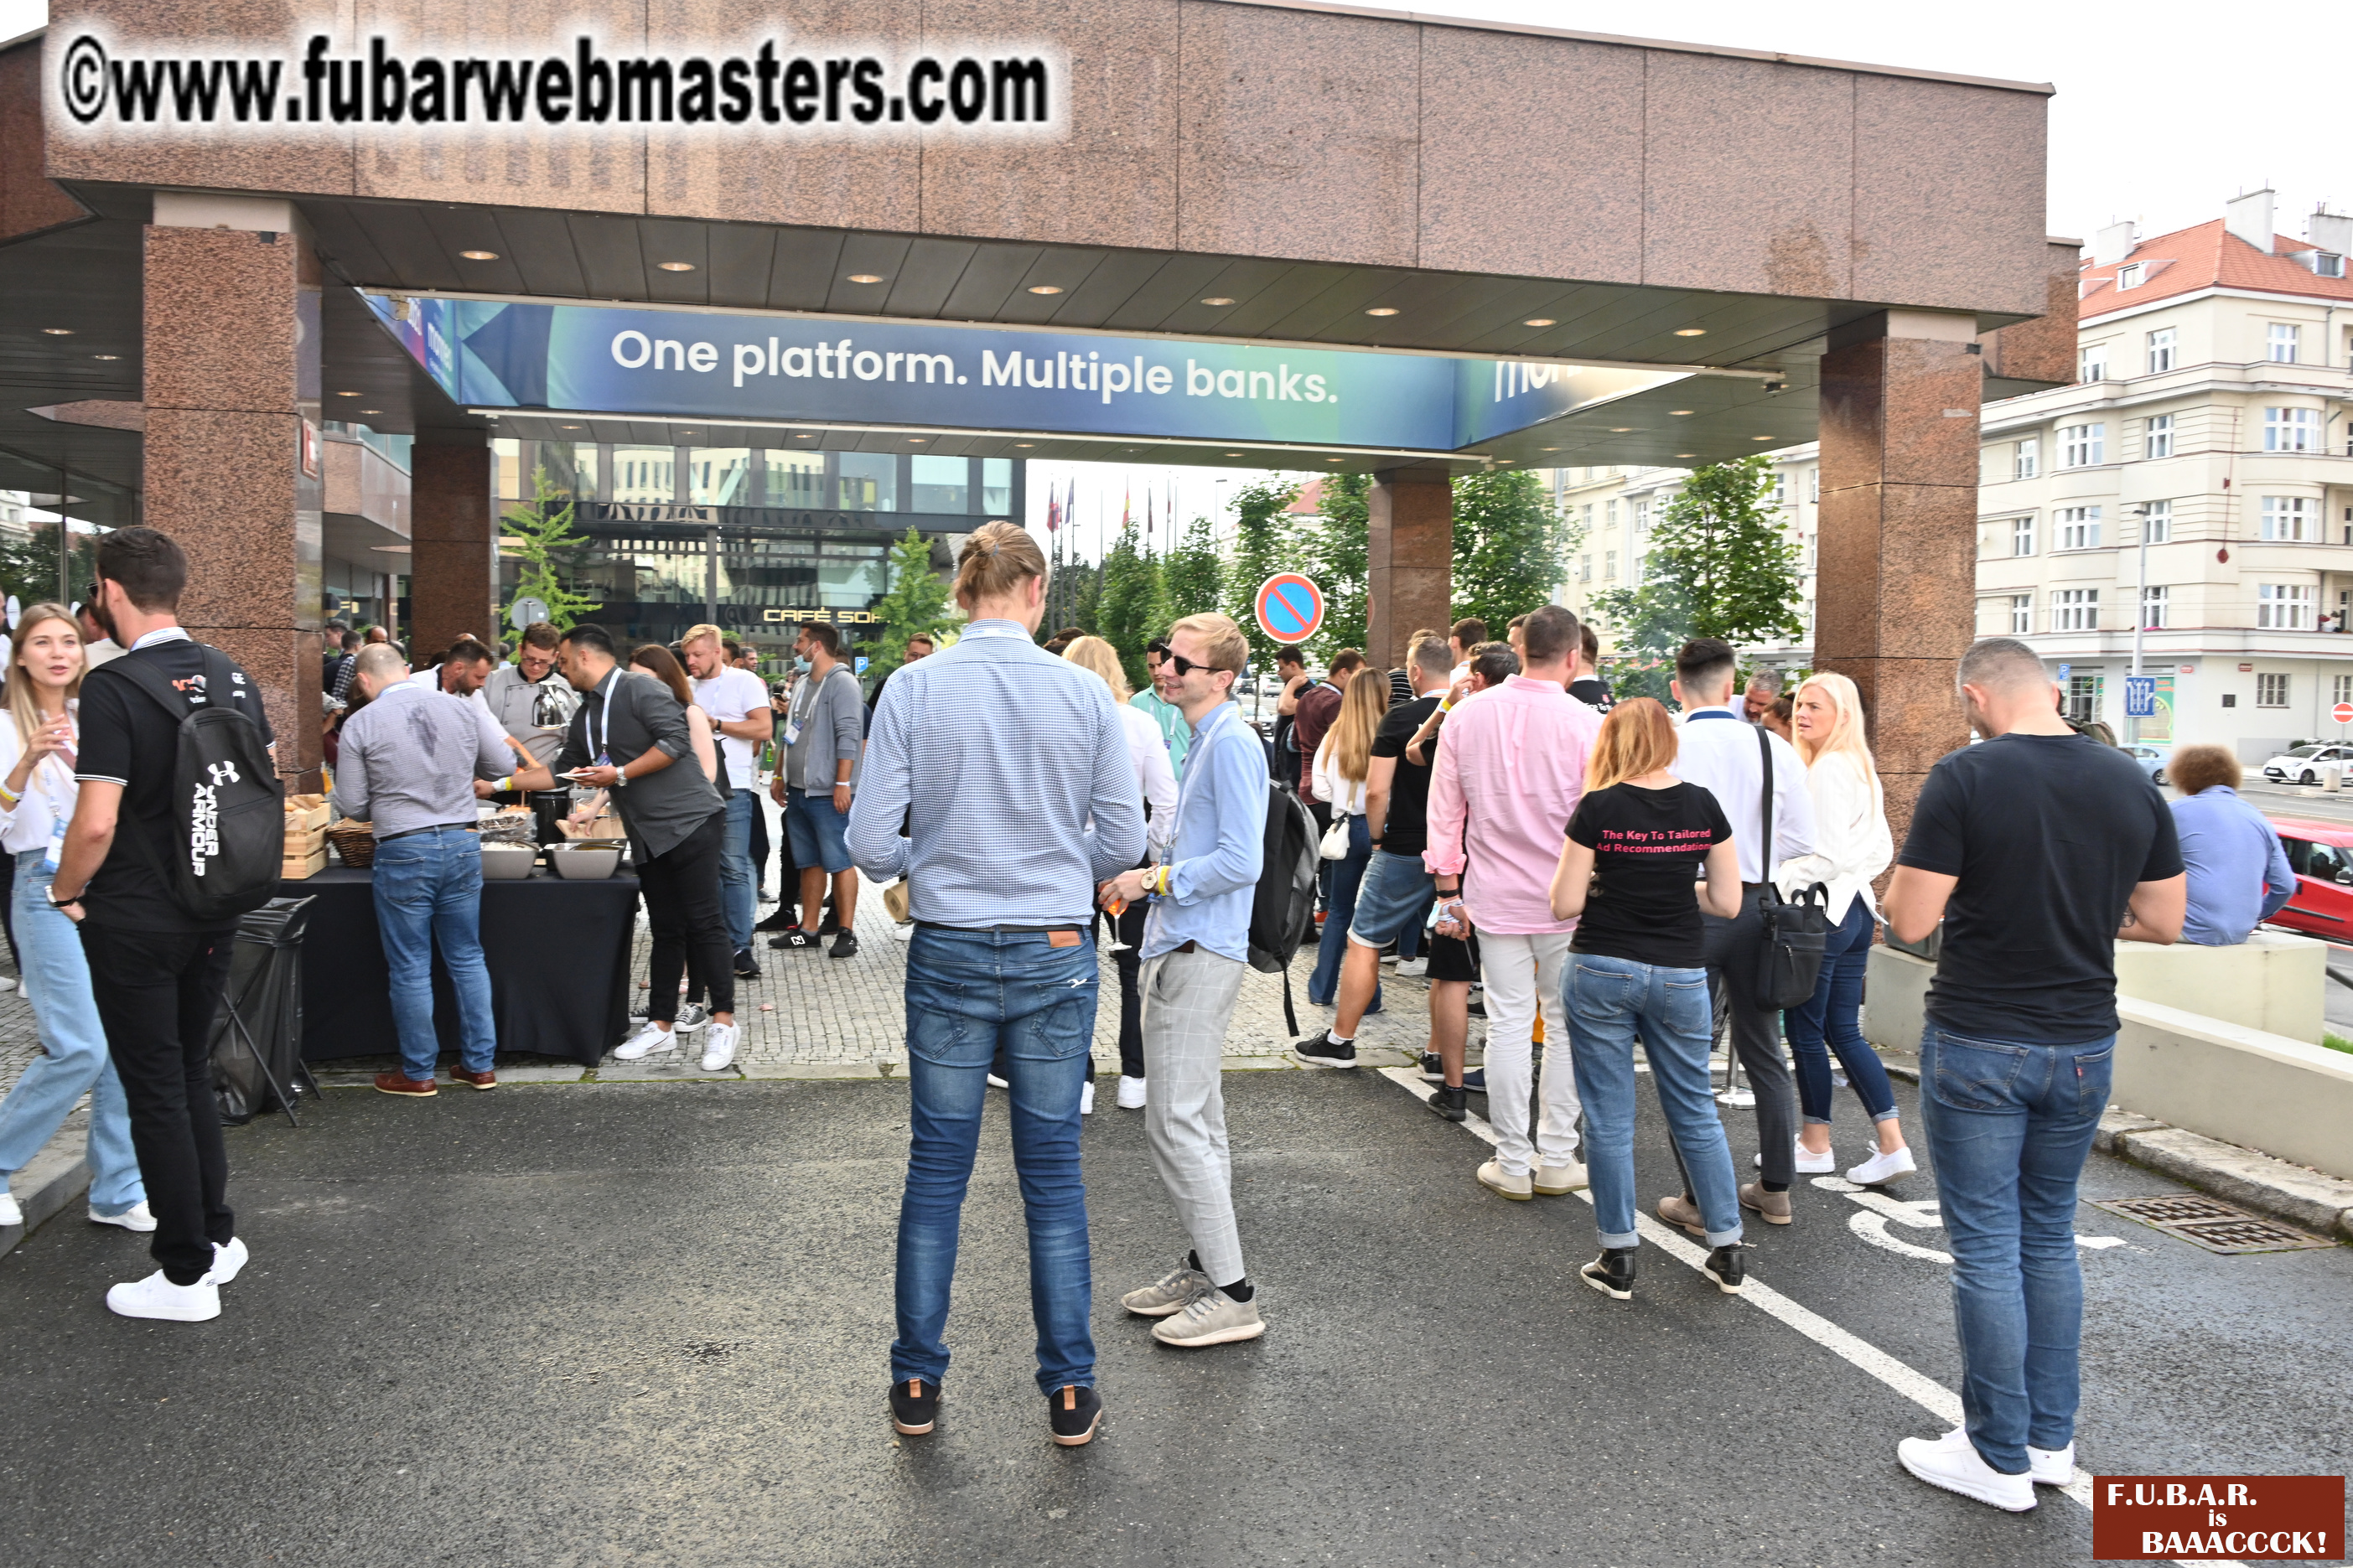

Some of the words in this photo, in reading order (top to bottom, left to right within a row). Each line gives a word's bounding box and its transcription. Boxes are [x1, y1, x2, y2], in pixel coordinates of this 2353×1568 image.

[611, 330, 718, 373] One
[733, 337, 968, 387] platform.
[982, 349, 1173, 404] Multiple
[1187, 359, 1338, 403] banks.
[764, 606, 832, 622] CAFÉ
[858, 659, 866, 669] P
[205, 784, 220, 856] UNDER
[191, 782, 207, 877] ARMOUR
[1602, 830, 1624, 840] The
[1626, 830, 1649, 842] Key
[1651, 831, 1665, 841] To
[1667, 828, 1712, 840] Tailored
[1596, 842, 1611, 851] Ad
